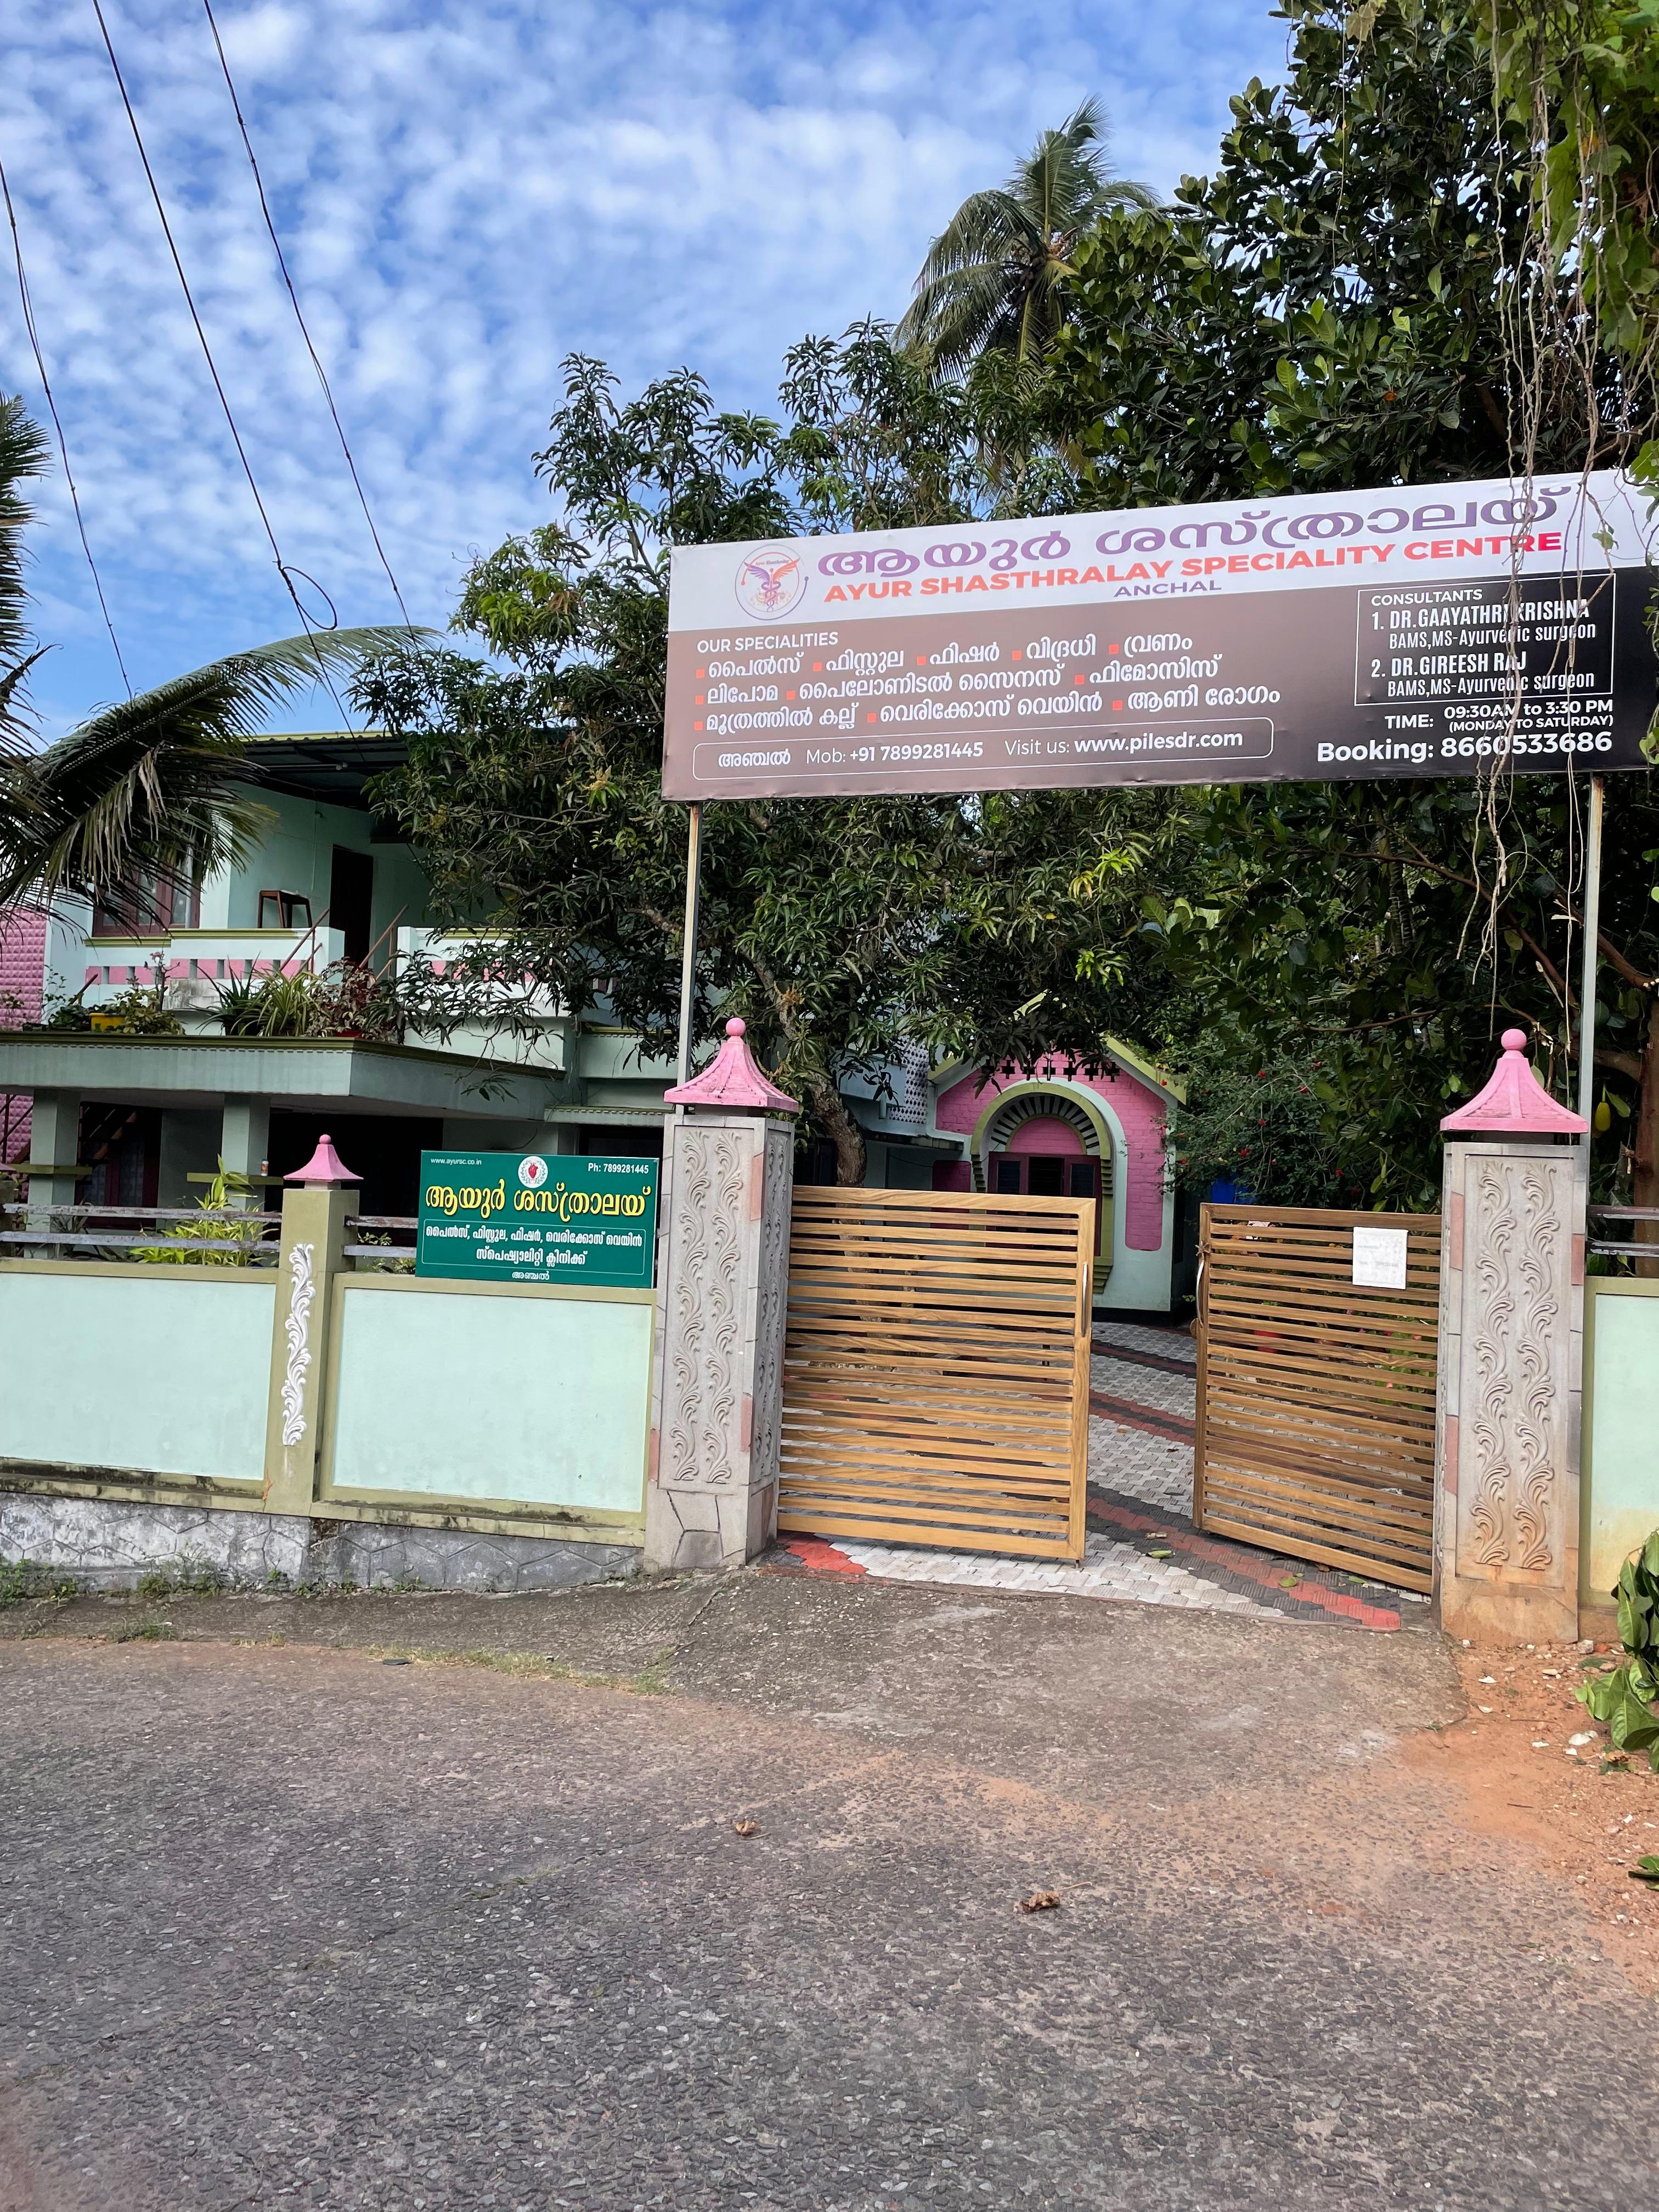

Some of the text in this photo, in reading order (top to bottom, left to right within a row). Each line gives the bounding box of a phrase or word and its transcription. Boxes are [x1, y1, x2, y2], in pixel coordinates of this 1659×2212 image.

[817, 530, 1071, 578] ആയുർ
[823, 532, 1562, 602] AYUR SHASTHRALAY SPECIALITY CENTRE
[1113, 580, 1222, 597] ANCHAL
[1370, 589, 1483, 606] CONSULTANTS
[1372, 612, 1384, 630] 1.
[697, 631, 838, 653] OUR SPECIALITIES
[708, 633, 1193, 678] പൈൽസ് ഫിസ്റ്റുല ഫിഷർ വിദ്രധി വ്രണം
[1371, 651, 1527, 678] 2. DR.GIREESH RAJ
[707, 653, 1223, 704] ലിപോമ പൈലോണിടൽ സൈനസ് ഫിമോസിസ്
[1533, 672, 1595, 691] surgeon
[706, 684, 1280, 736] മൂത്രത്തിൽ കല്ല് വെരിക്കോസ് വെയിൻ ആണി രോഗം
[1443, 699, 1613, 719] 09:30AM to 3:30 PM
[1385, 715, 1434, 730] TIME:
[1449, 715, 1613, 733] (MONDAY TO SATURDAY)
[718, 748, 791, 768] അഞ്ചൽ
[806, 731, 1243, 764] Mob: +91 7899281445 Visit us: www.pilesdr.com
[1317, 731, 1613, 763] Booking: 8660533686
[588, 1163, 649, 1174] Ph: 7899281445
[425, 1178, 506, 1219] ആയുർ
